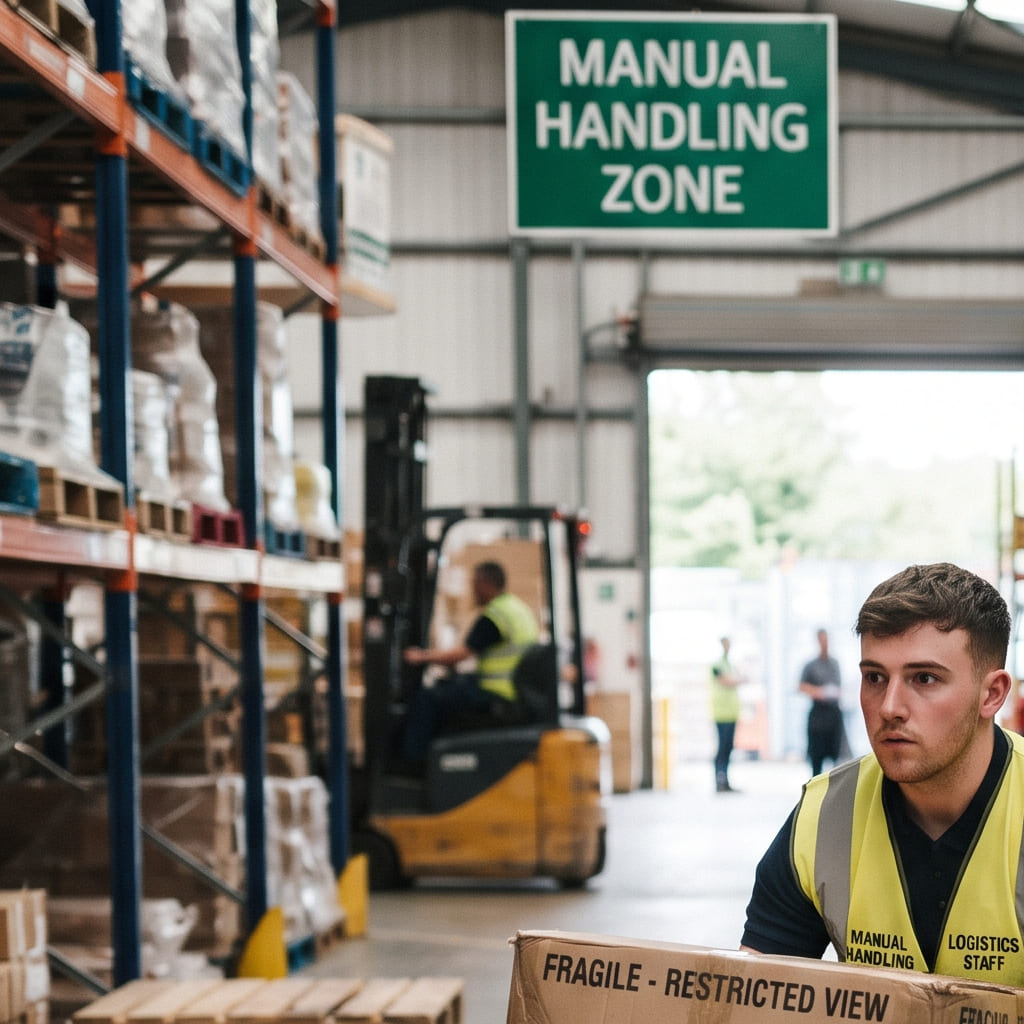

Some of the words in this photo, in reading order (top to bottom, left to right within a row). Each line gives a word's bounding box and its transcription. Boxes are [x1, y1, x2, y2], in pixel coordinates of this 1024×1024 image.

[560, 38, 788, 89] MANUAL
[536, 101, 808, 152] HANDLING
[601, 164, 744, 214] ZONE
[846, 946, 914, 970] HANDLING
[851, 930, 907, 951] MANUAL
[949, 934, 1020, 953] LOGISTICS
[963, 955, 1005, 971] STAFF
[543, 953, 642, 992] FRAGILE
[664, 968, 815, 1013] RESTRICTED
[825, 987, 890, 1022] VIEW
